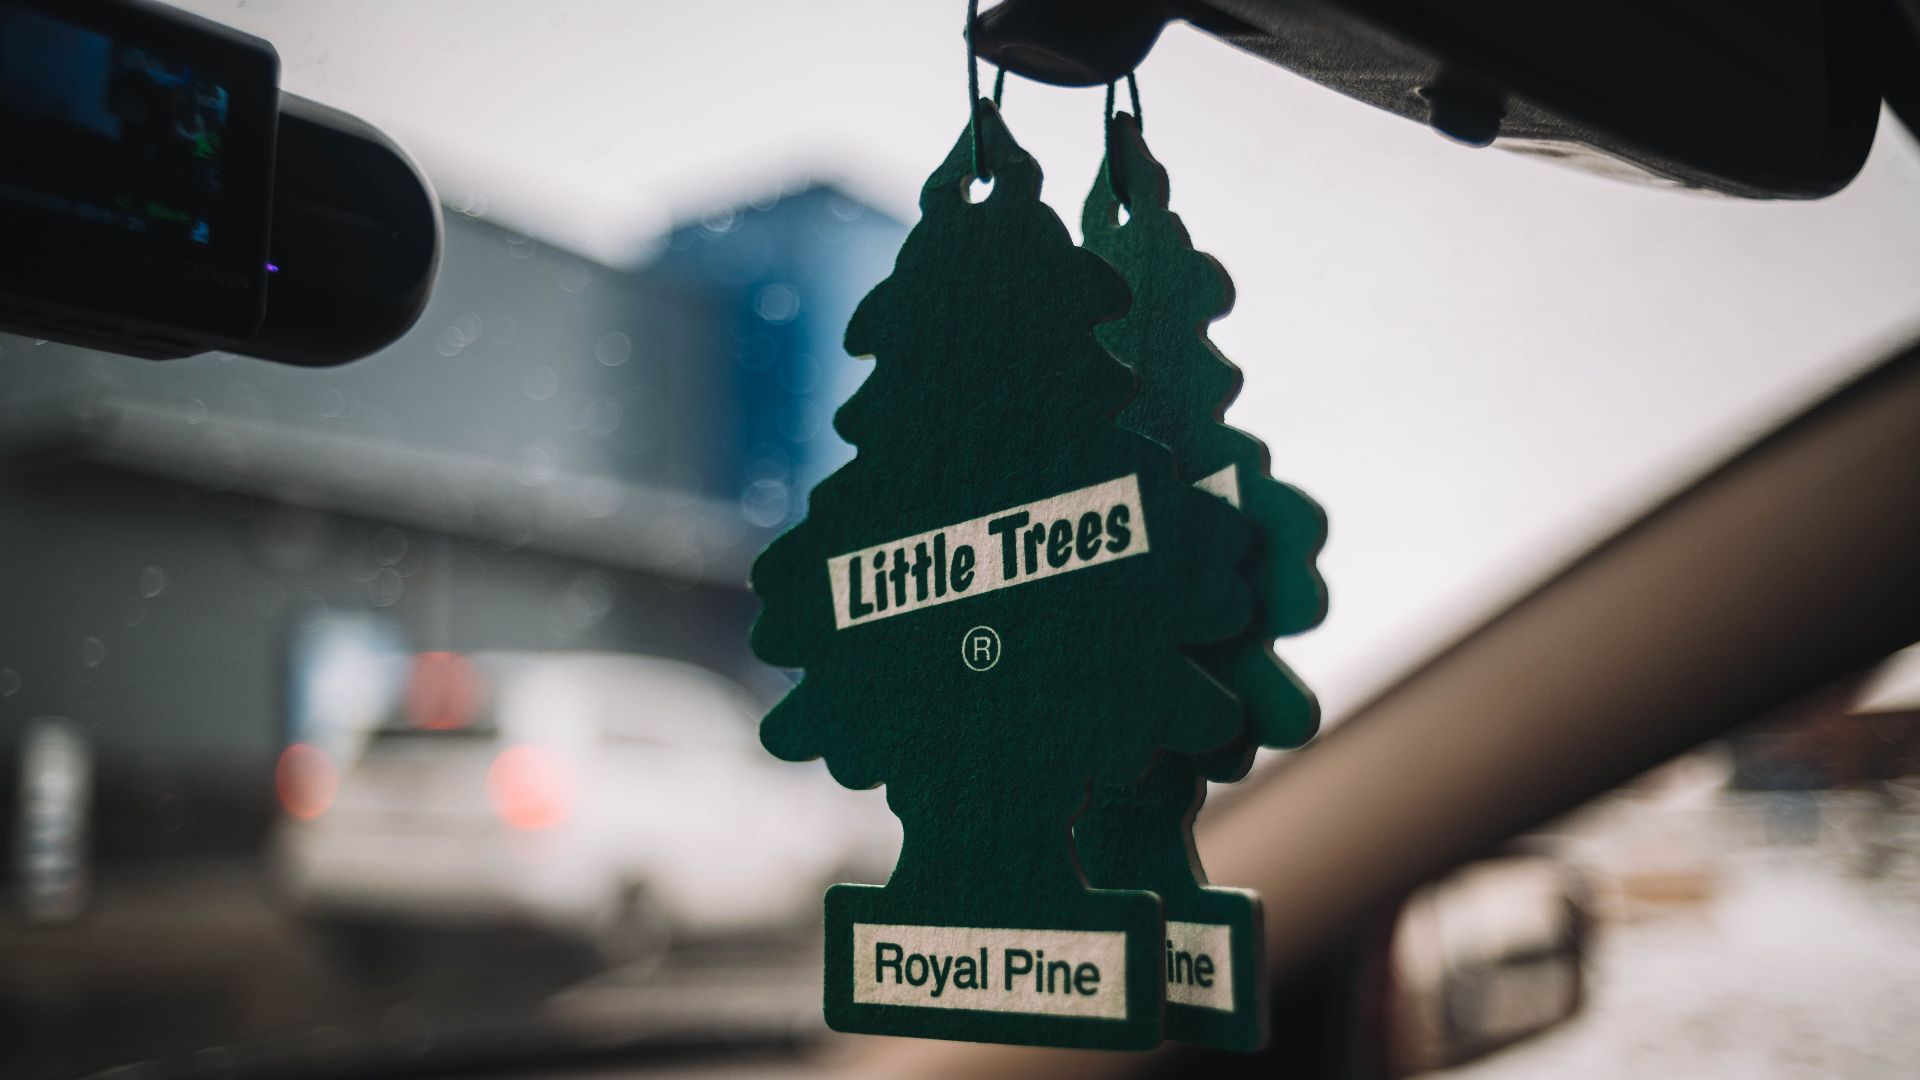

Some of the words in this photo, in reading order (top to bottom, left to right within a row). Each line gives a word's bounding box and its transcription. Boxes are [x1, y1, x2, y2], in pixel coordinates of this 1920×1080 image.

[848, 533, 976, 620] Little
[988, 504, 1133, 582] Trees
[874, 942, 988, 996] Royal
[1004, 949, 1101, 996] Pine
[1166, 940, 1215, 988] ine
